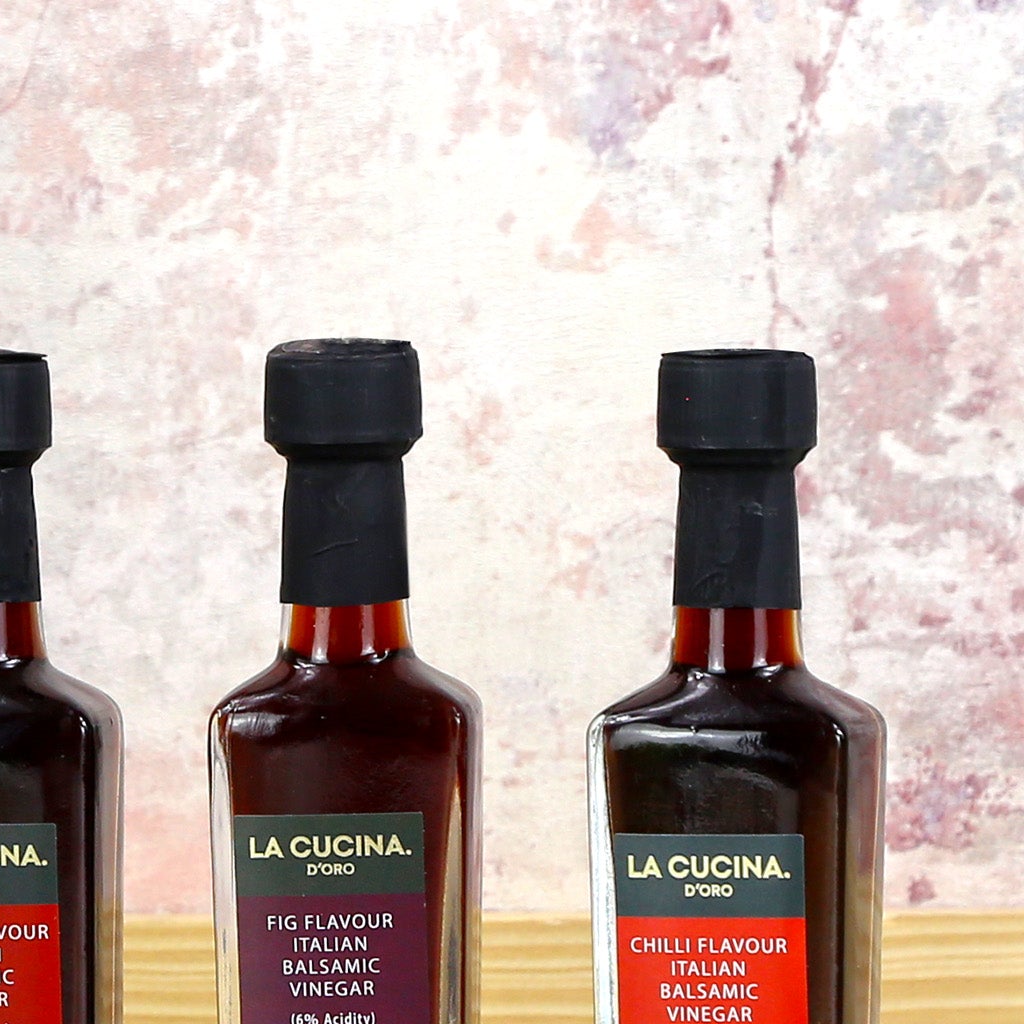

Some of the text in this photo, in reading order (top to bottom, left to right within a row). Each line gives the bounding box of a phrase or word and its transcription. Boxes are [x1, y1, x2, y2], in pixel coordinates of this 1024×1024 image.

[249, 834, 412, 859] LA CUCINA.
[628, 855, 791, 879] LA CUCINA.
[267, 913, 393, 931] FIG FLAVOUR
[293, 936, 367, 952] ITALIAN
[630, 937, 787, 953] CHILLI FLAVOUR
[282, 958, 380, 975] BALSAMIC
[671, 961, 746, 976] ITALIAN
[289, 980, 375, 997] VINEGAR
[660, 983, 759, 1000] BALSAMIC
[666, 1006, 752, 1022] VINEGAR
